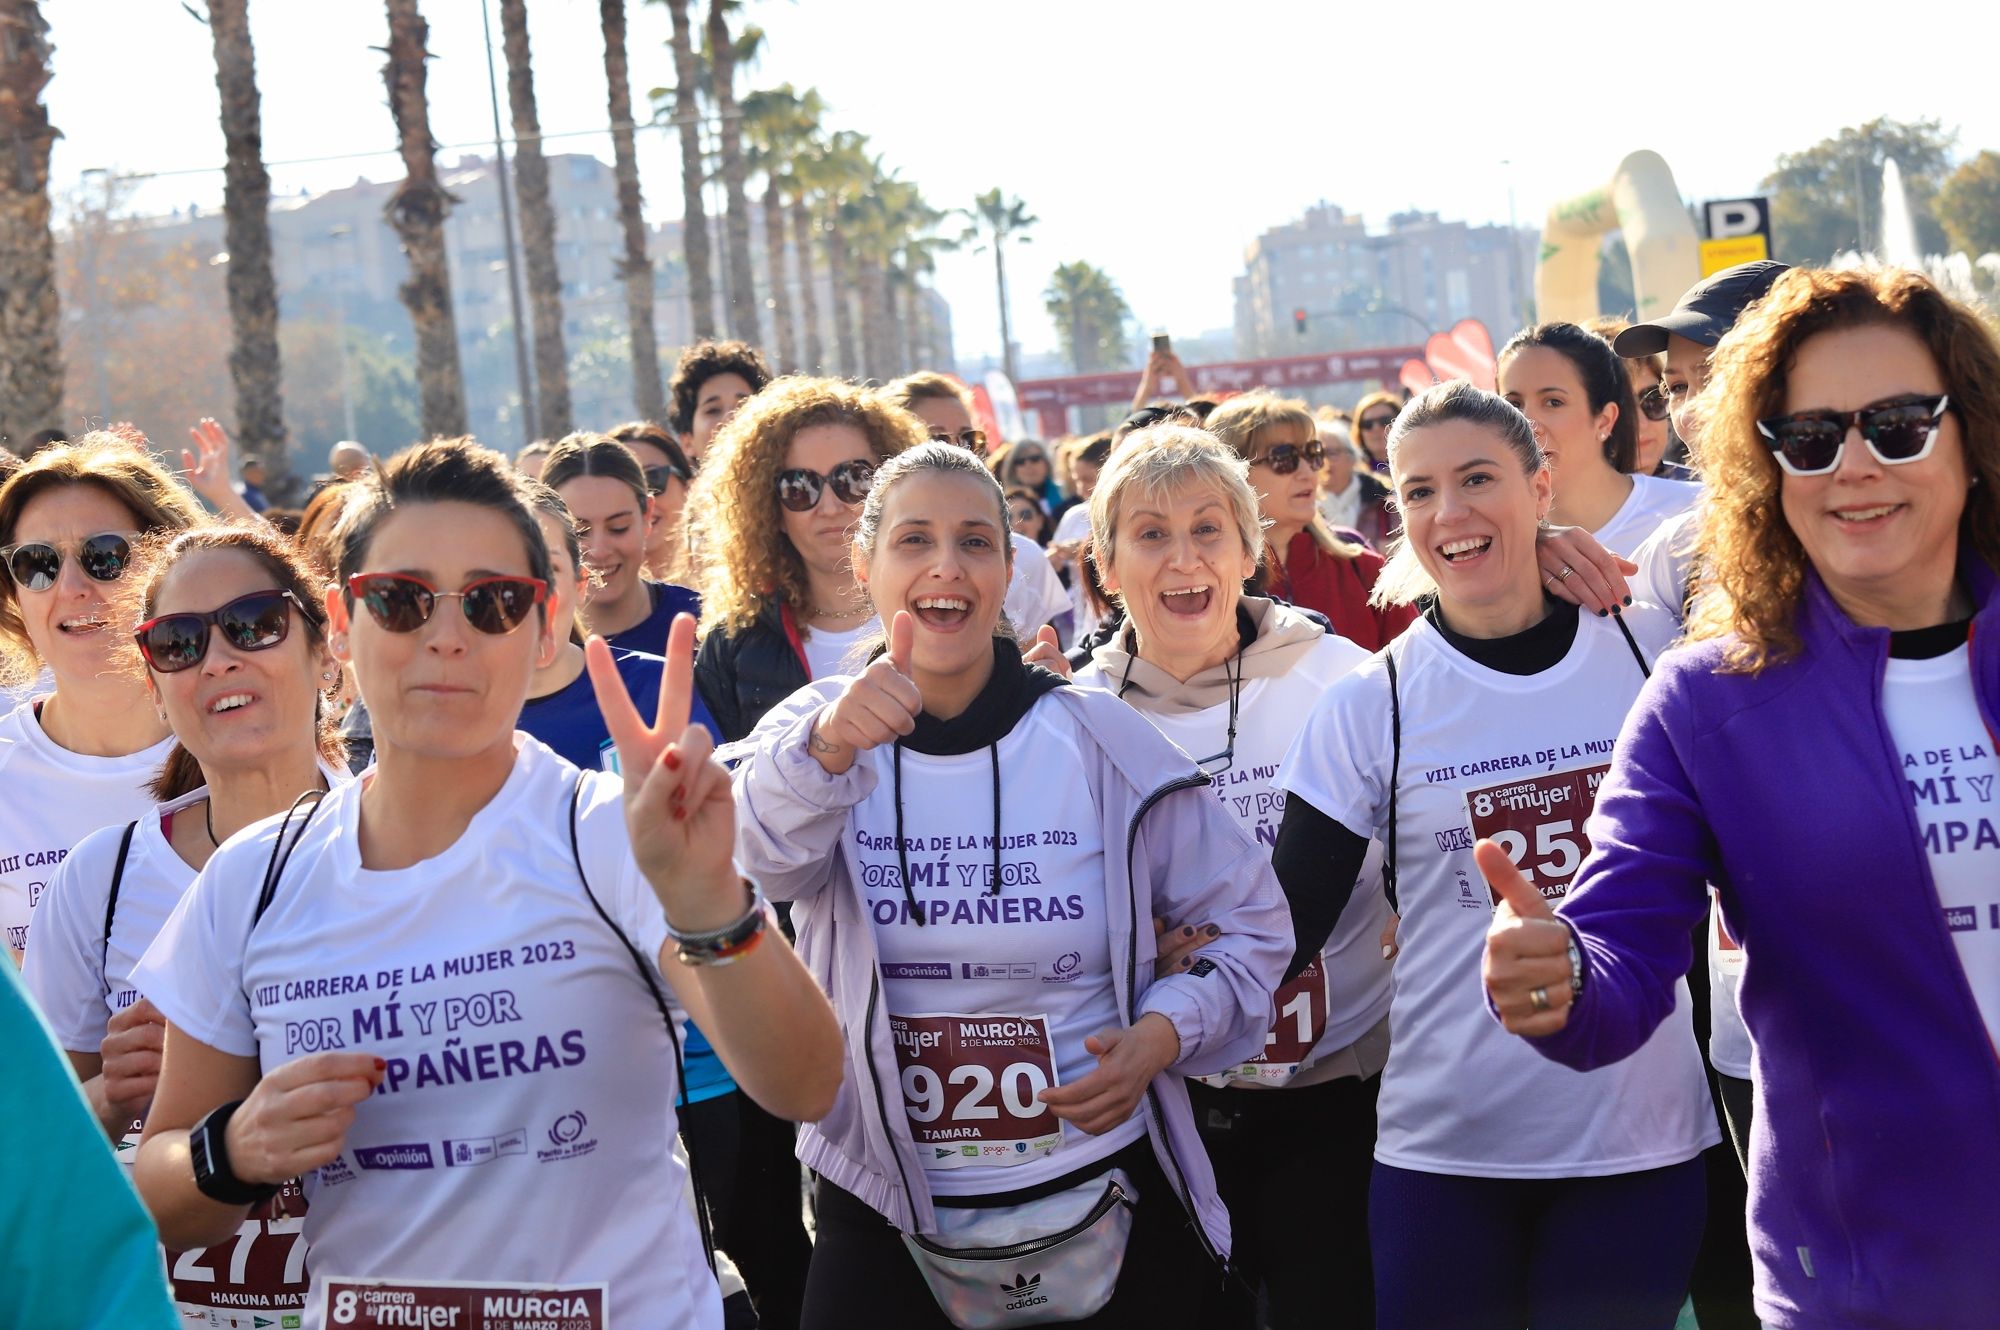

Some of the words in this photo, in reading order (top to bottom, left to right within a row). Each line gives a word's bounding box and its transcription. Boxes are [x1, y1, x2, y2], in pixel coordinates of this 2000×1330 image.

[1709, 201, 1760, 240] P
[1426, 766, 1457, 784] VIII
[1460, 754, 1532, 776] CARRERA
[1535, 749, 1557, 764] DE
[1560, 745, 1581, 760] LA
[1584, 739, 1617, 755] MUJ
[1903, 753, 1918, 767] A
[1924, 749, 1952, 765] DE
[1959, 744, 1987, 761] LA
[1230, 770, 1249, 785] LA
[1586, 772, 1607, 789] M
[1907, 766, 1961, 807] MÍ
[1966, 774, 1994, 803] Y
[1495, 783, 1537, 799] carrera
[1509, 785, 1572, 816] mujer
[1233, 795, 1251, 817] Y
[1256, 792, 1286, 814] PO
[856, 829, 925, 852] CARRERA
[930, 836, 952, 851] DE
[957, 835, 978, 850] LA
[983, 833, 1038, 850] MUJER
[1042, 830, 1078, 846] 2023
[1922, 818, 2000, 854] MPA
[25, 848, 72, 867] CARR
[1486, 818, 1592, 883] 25
[860, 860, 903, 889] OR
[909, 853, 950, 888] MÍ
[957, 864, 978, 888] Y
[983, 861, 1042, 888] POR
[867, 890, 1085, 926] OMPAÑERAS
[1947, 911, 1974, 927] ión
[256, 984, 280, 1007] VIII
[284, 974, 369, 1001] CARRERA
[376, 969, 403, 989] DE
[411, 963, 436, 983] LA
[443, 949, 514, 978] MUJER
[521, 940, 576, 965] 2023
[117, 990, 137, 1008] VIII
[286, 1017, 345, 1054] POR
[352, 991, 403, 1044] MÍ
[411, 1001, 437, 1036] Y
[445, 990, 521, 1031] POR
[891, 1020, 908, 1031] era
[1266, 991, 1312, 1044] 1
[960, 1023, 1037, 1038] MURCIA
[961, 1040, 967, 1048] 5
[969, 1039, 981, 1047] DE
[984, 1038, 1015, 1047] MARZO
[1018, 1037, 1040, 1046] 2023
[371, 1030, 586, 1095] PAÑERAS
[901, 1062, 1049, 1123] 920
[923, 1127, 982, 1140] TAMARA
[283, 1188, 290, 1197] 5
[293, 1187, 301, 1196] D
[210, 1292, 270, 1306] HAKUNA
[274, 1292, 309, 1306] MAT
[363, 1290, 415, 1305] carrera
[483, 1297, 589, 1319] MURCIA
[1006, 1295, 1048, 1310] adidas
[377, 1303, 461, 1330] mujer
[483, 1321, 490, 1330] 5
[494, 1321, 510, 1330] DE
[513, 1321, 558, 1330] MARZO
[561, 1320, 592, 1330] 2023
